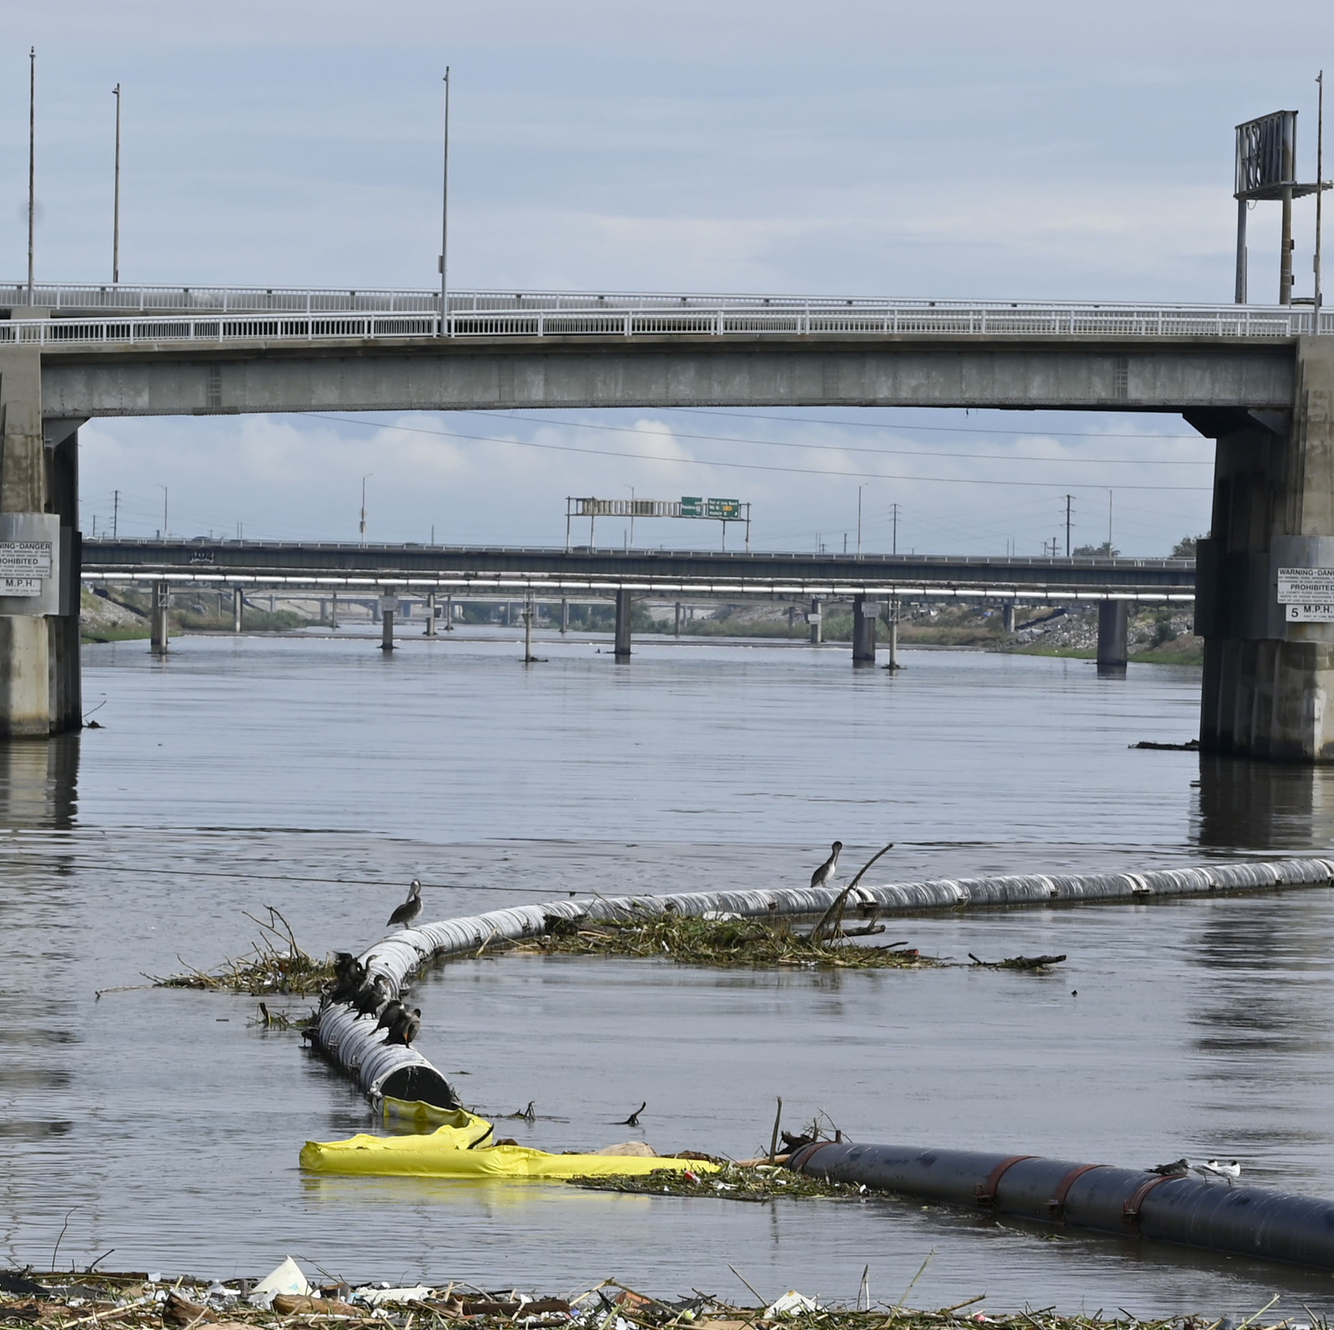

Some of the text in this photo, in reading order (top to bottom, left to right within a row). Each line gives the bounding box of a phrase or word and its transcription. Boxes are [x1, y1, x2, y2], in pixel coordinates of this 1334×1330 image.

[5, 579, 35, 587] M.P.H.
[1291, 607, 1299, 618] 5
[1303, 605, 1333, 613] M.P.H.
